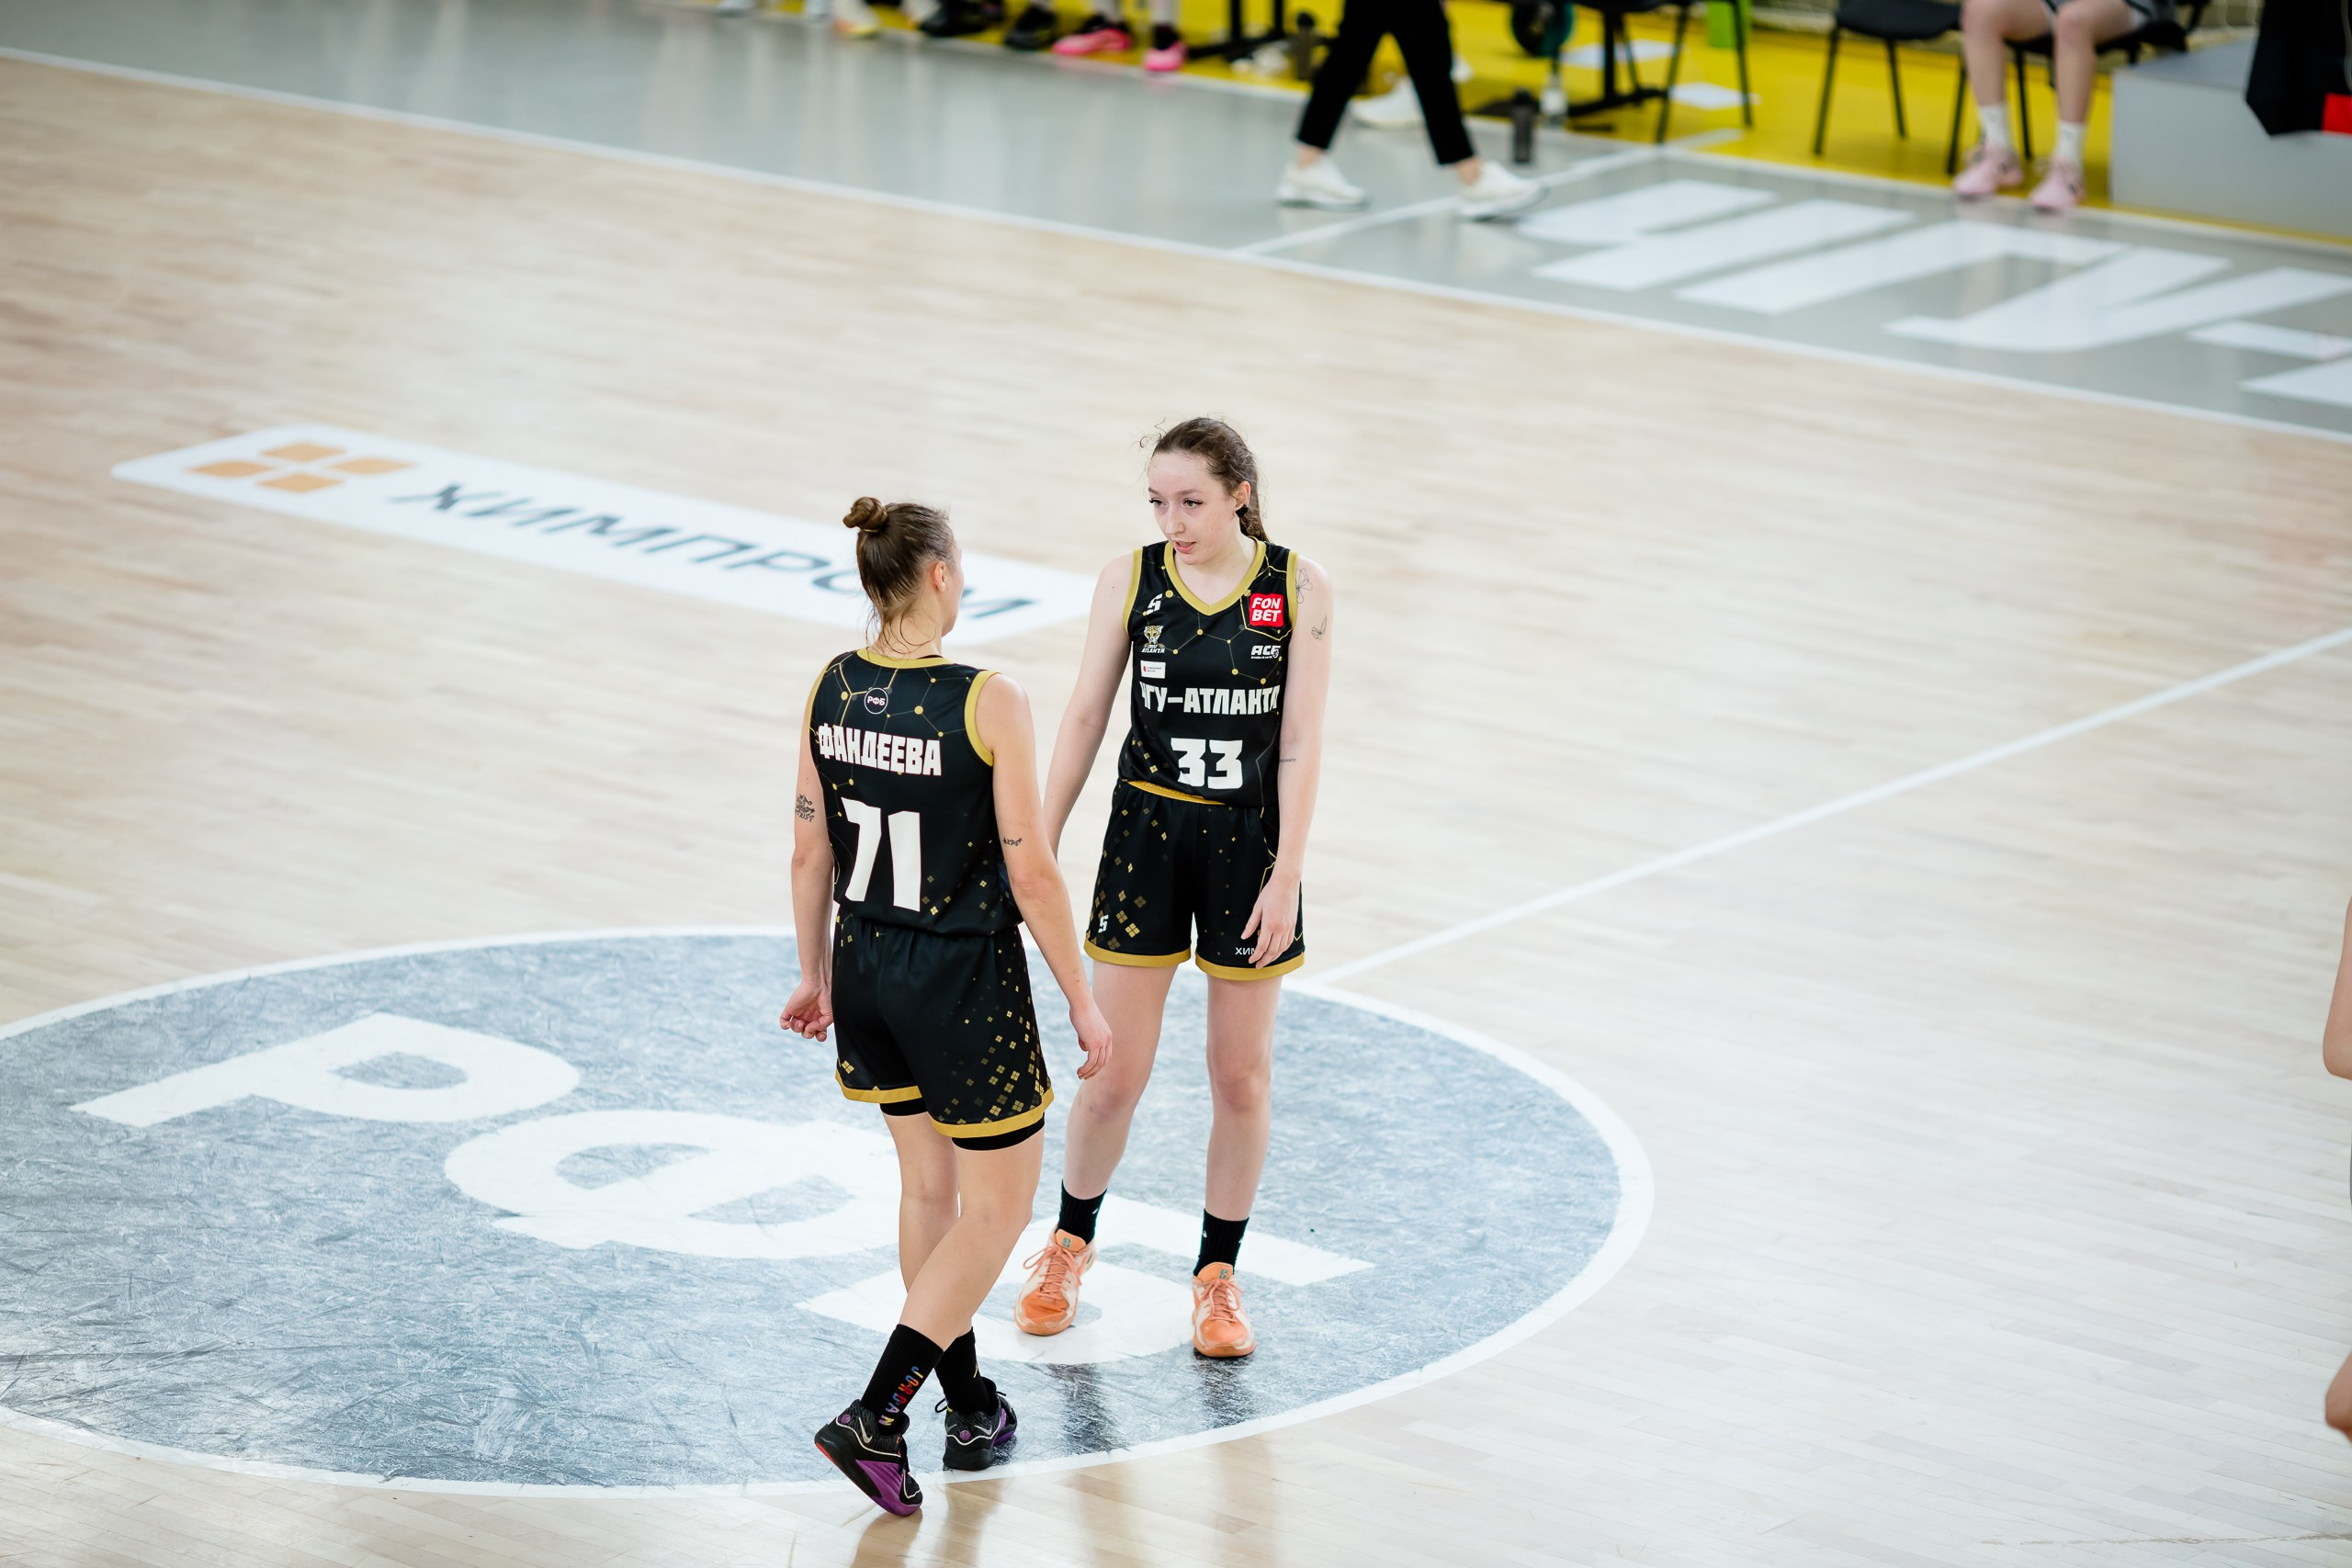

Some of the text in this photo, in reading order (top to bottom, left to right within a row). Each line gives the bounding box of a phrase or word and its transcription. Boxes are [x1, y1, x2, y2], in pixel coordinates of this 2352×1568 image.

[1251, 597, 1281, 608] FON
[1251, 610, 1282, 622] BET
[866, 695, 886, 706] РФБ
[818, 723, 942, 776] ФАНДЕЕВА
[1170, 738, 1243, 790] 33
[841, 796, 921, 912] 71
[71, 1011, 1375, 1366] РФБ
